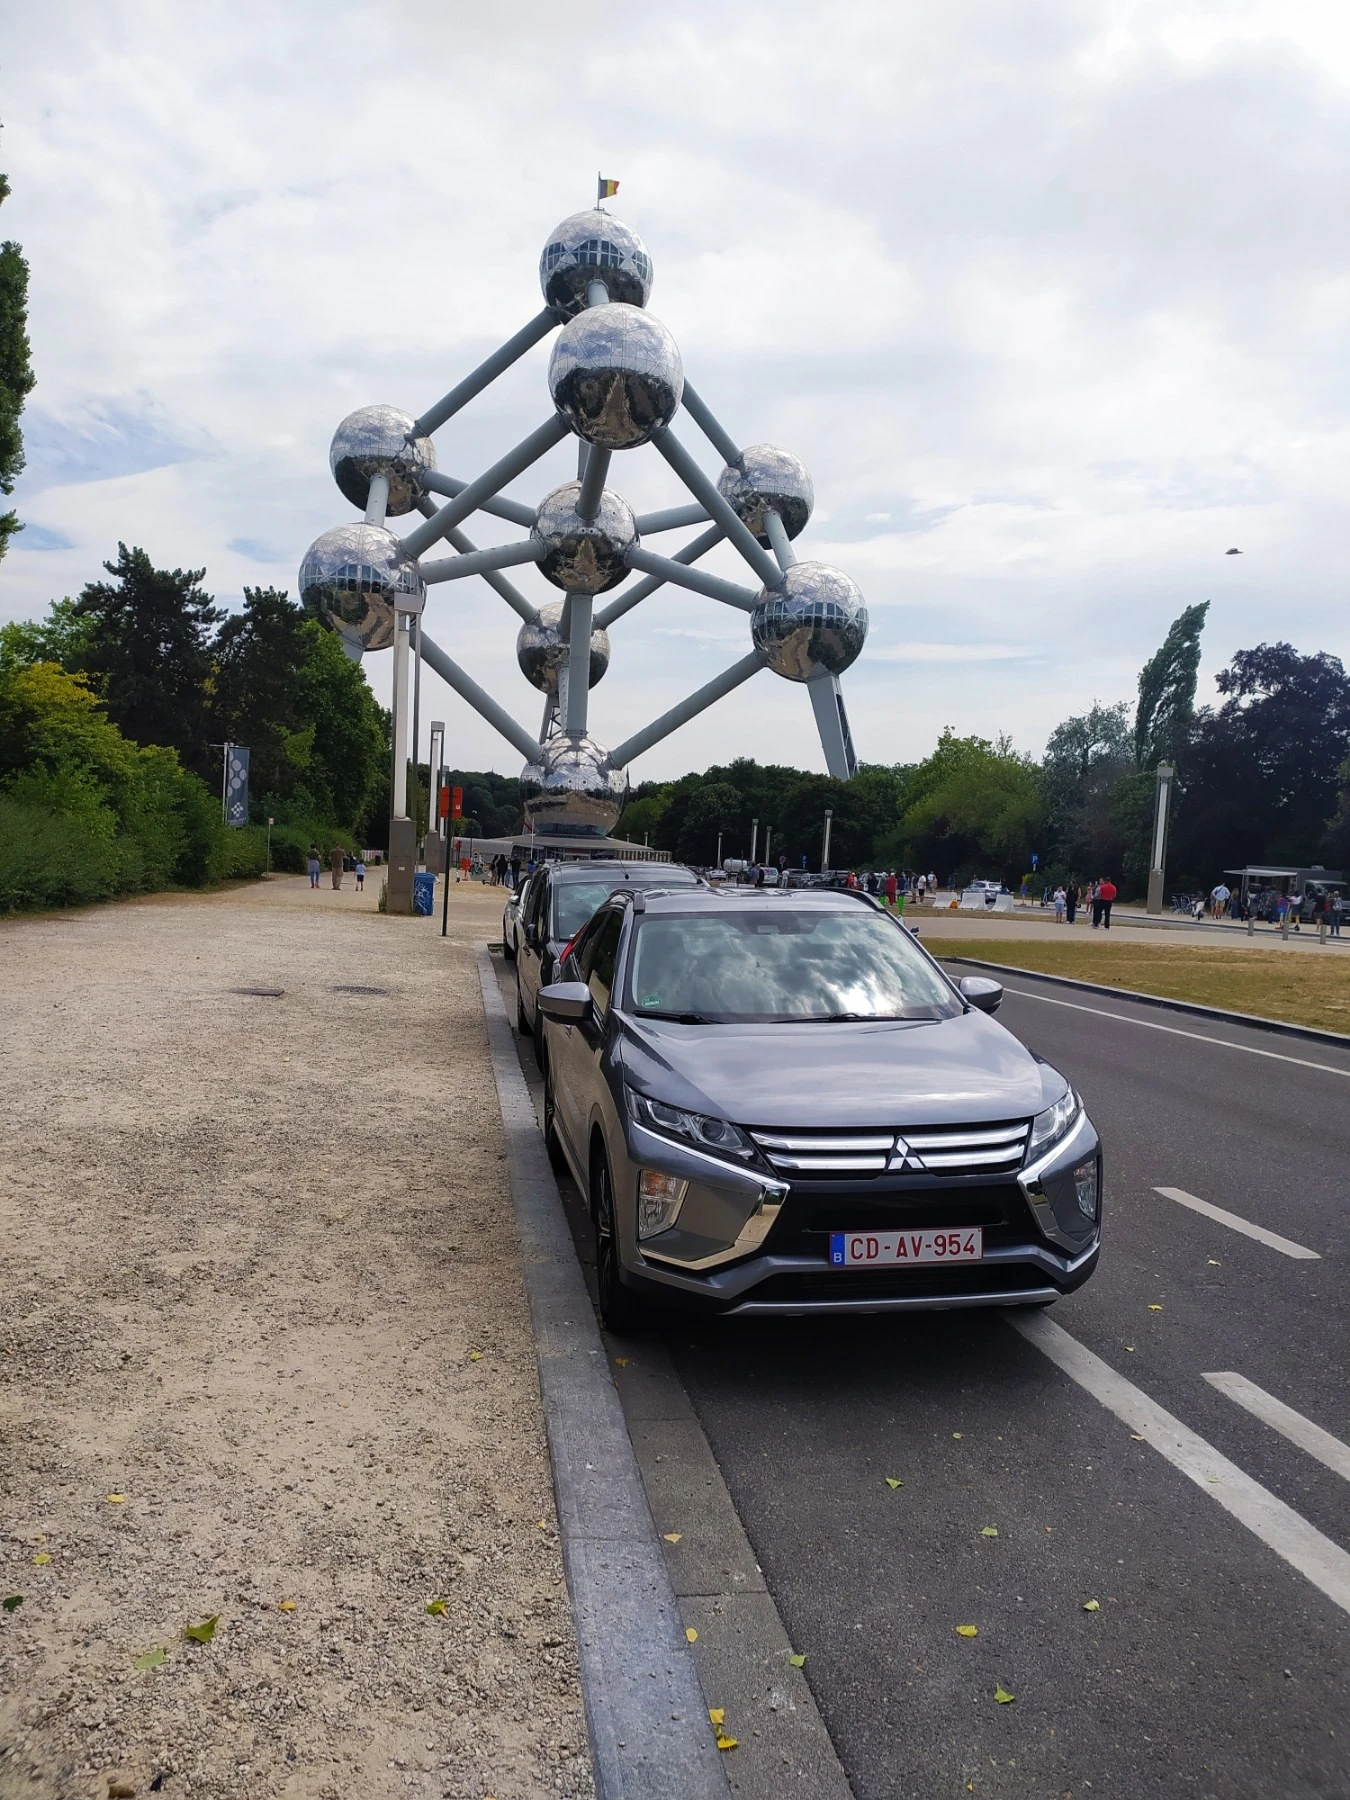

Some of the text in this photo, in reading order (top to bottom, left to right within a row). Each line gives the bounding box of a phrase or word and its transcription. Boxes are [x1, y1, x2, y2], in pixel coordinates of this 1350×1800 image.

[1032, 855, 1038, 863] P
[833, 1233, 976, 1263] B CD-AV-954
